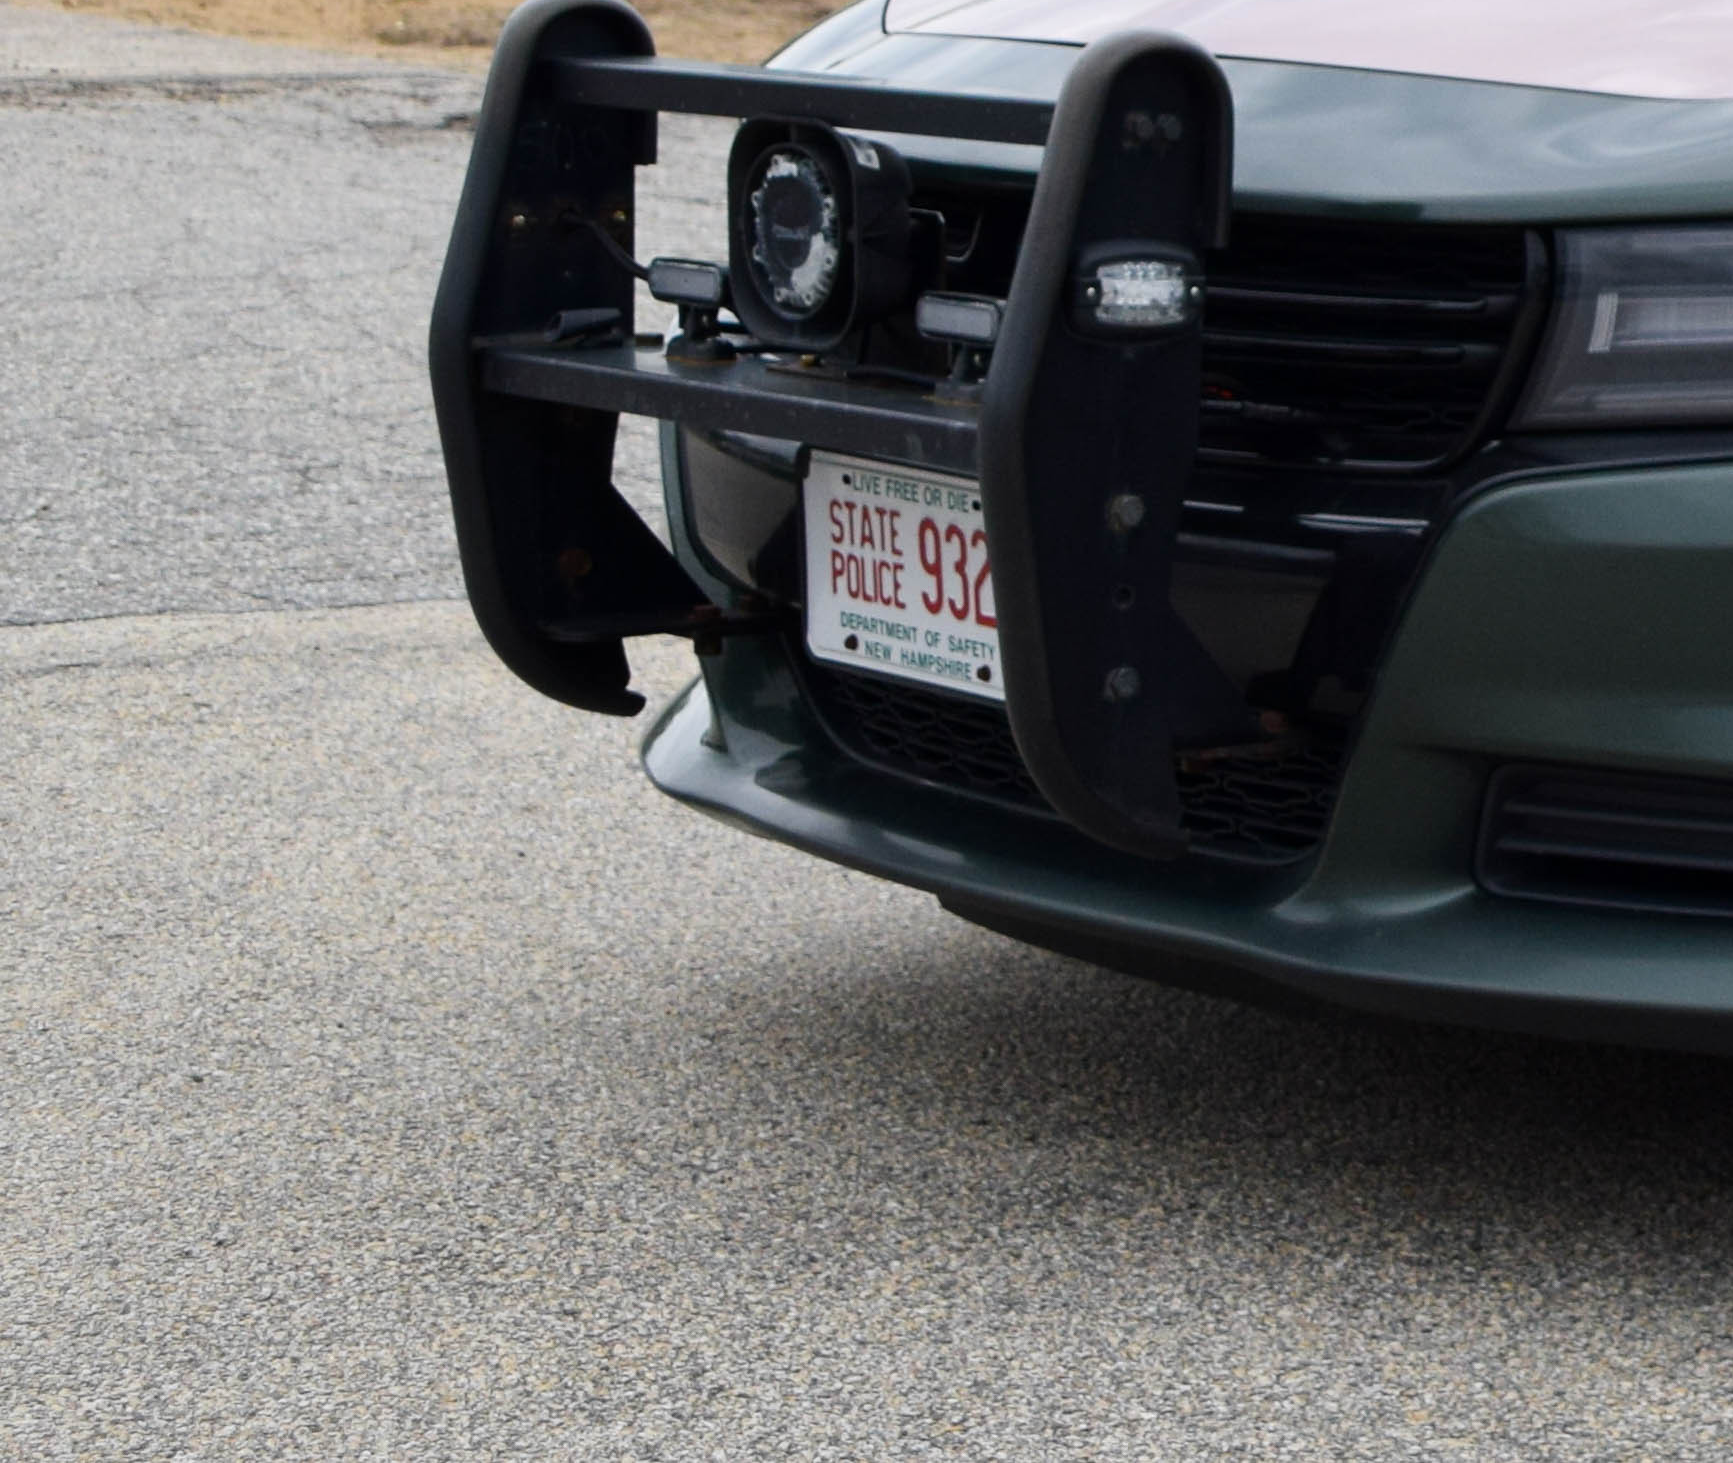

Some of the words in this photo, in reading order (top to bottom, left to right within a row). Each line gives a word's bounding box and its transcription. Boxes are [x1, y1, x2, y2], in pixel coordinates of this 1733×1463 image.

[852, 471, 881, 495] LIVE
[885, 479, 919, 503] FREE
[923, 485, 943, 506] OR
[948, 491, 969, 513] DIE
[829, 498, 903, 557] STATE
[831, 549, 907, 609] POLICE
[918, 516, 998, 628] 932
[840, 611, 917, 643] DEPARTMENT
[924, 630, 941, 648] OF
[948, 635, 995, 660] SAFETY
[864, 641, 892, 660] NEW
[900, 648, 973, 682] HAMPSHIRE
